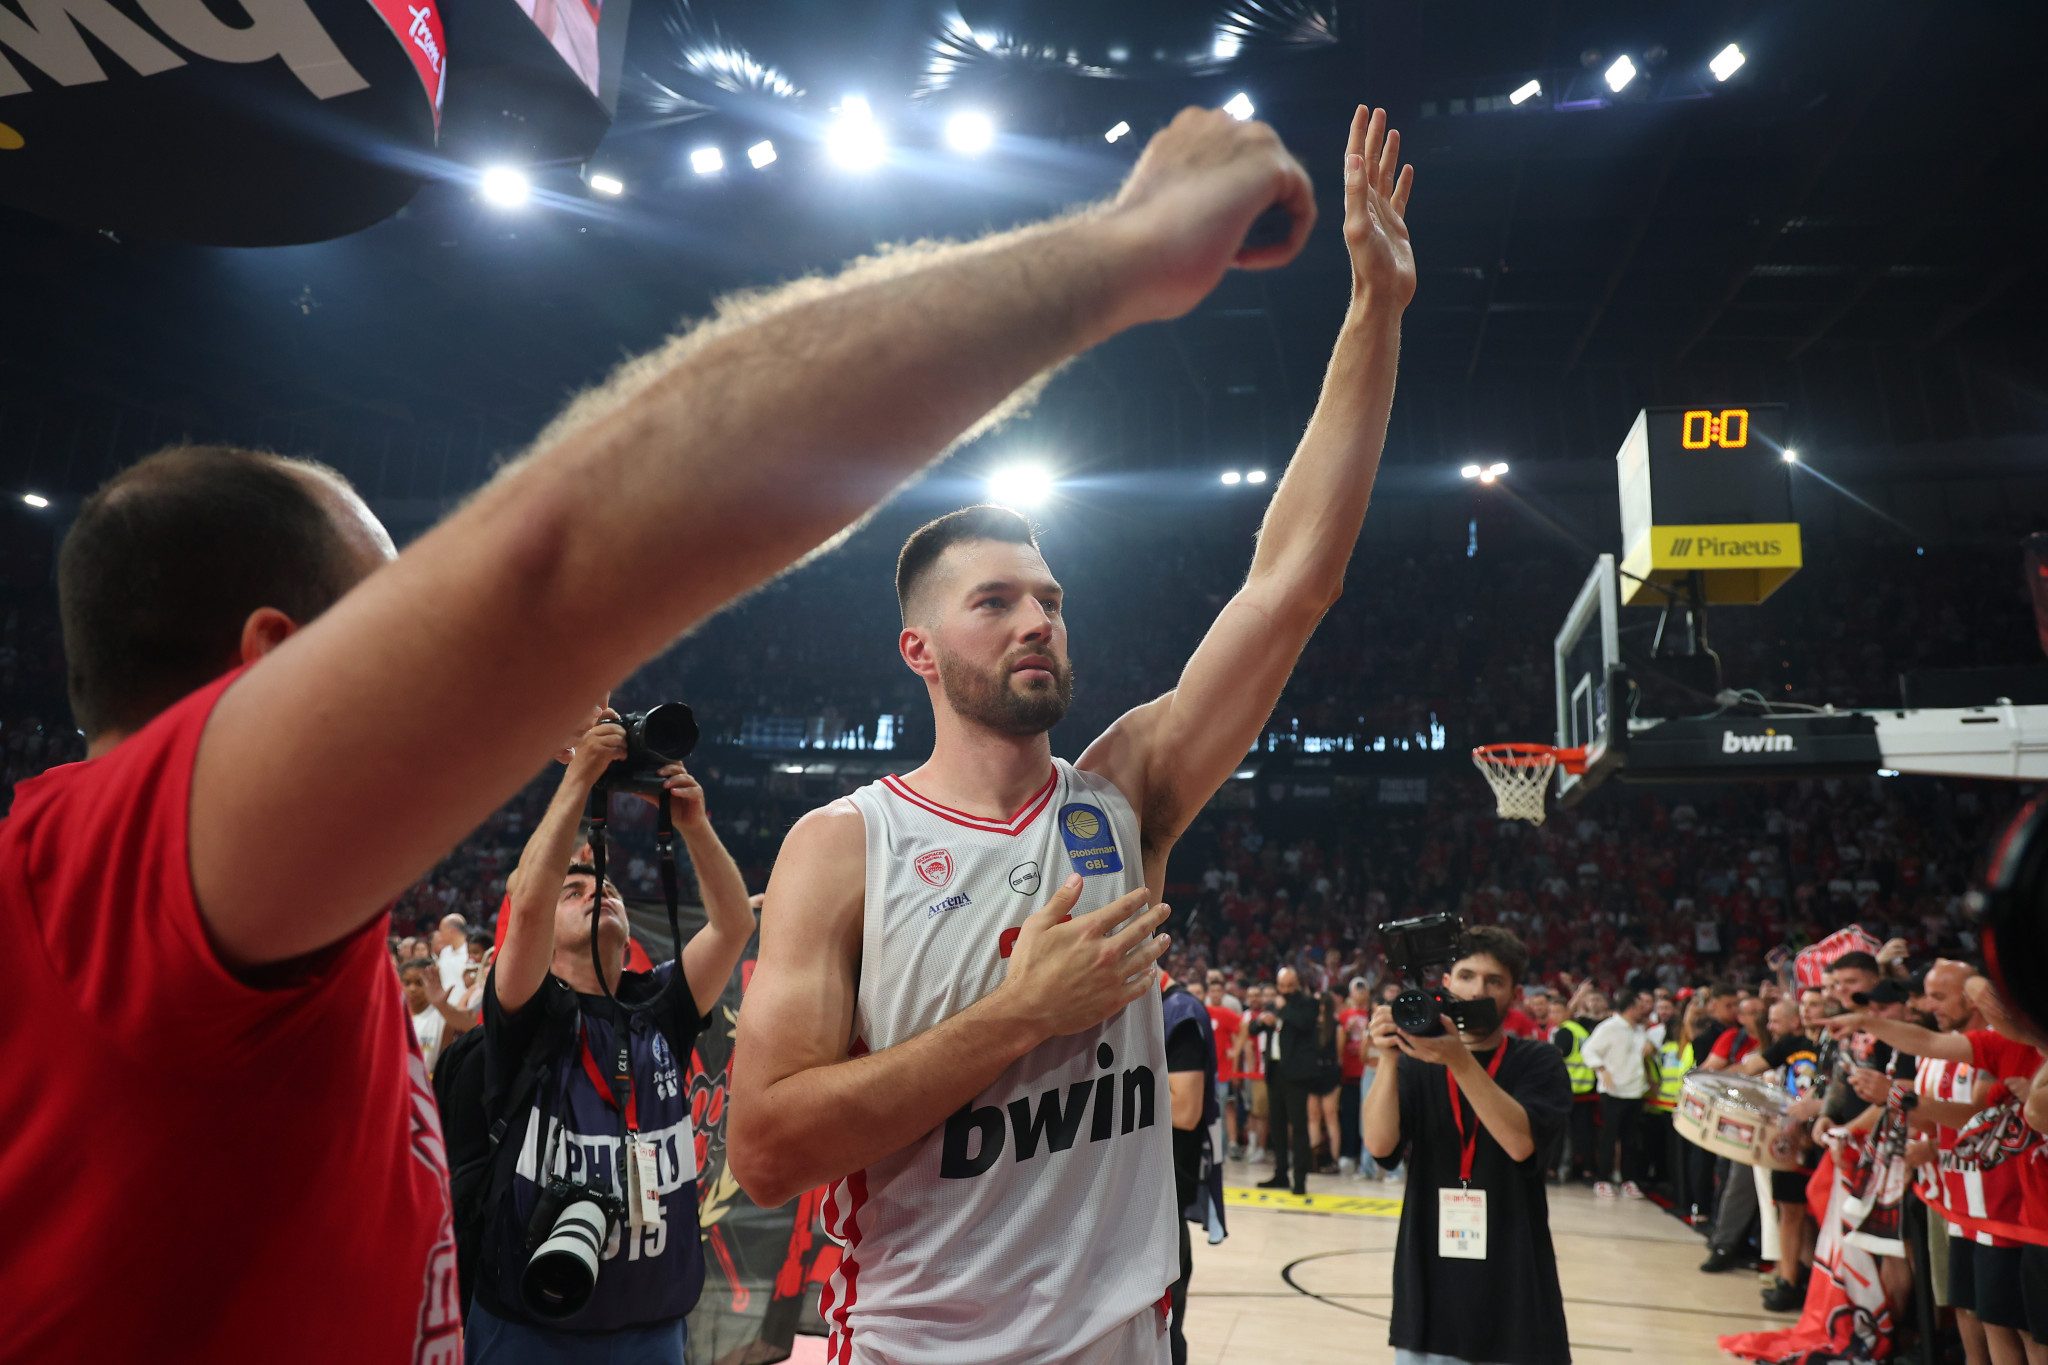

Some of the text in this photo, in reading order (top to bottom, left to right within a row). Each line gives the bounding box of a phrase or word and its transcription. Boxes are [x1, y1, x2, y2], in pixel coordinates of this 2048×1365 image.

[408, 4, 440, 74] from
[1683, 409, 1749, 449] 0:0
[1697, 536, 1783, 557] Piraeus
[1722, 728, 1794, 754] bwin
[1069, 846, 1116, 859] Stoiximan
[1085, 859, 1109, 870] GBL
[940, 1042, 1155, 1179] bwin
